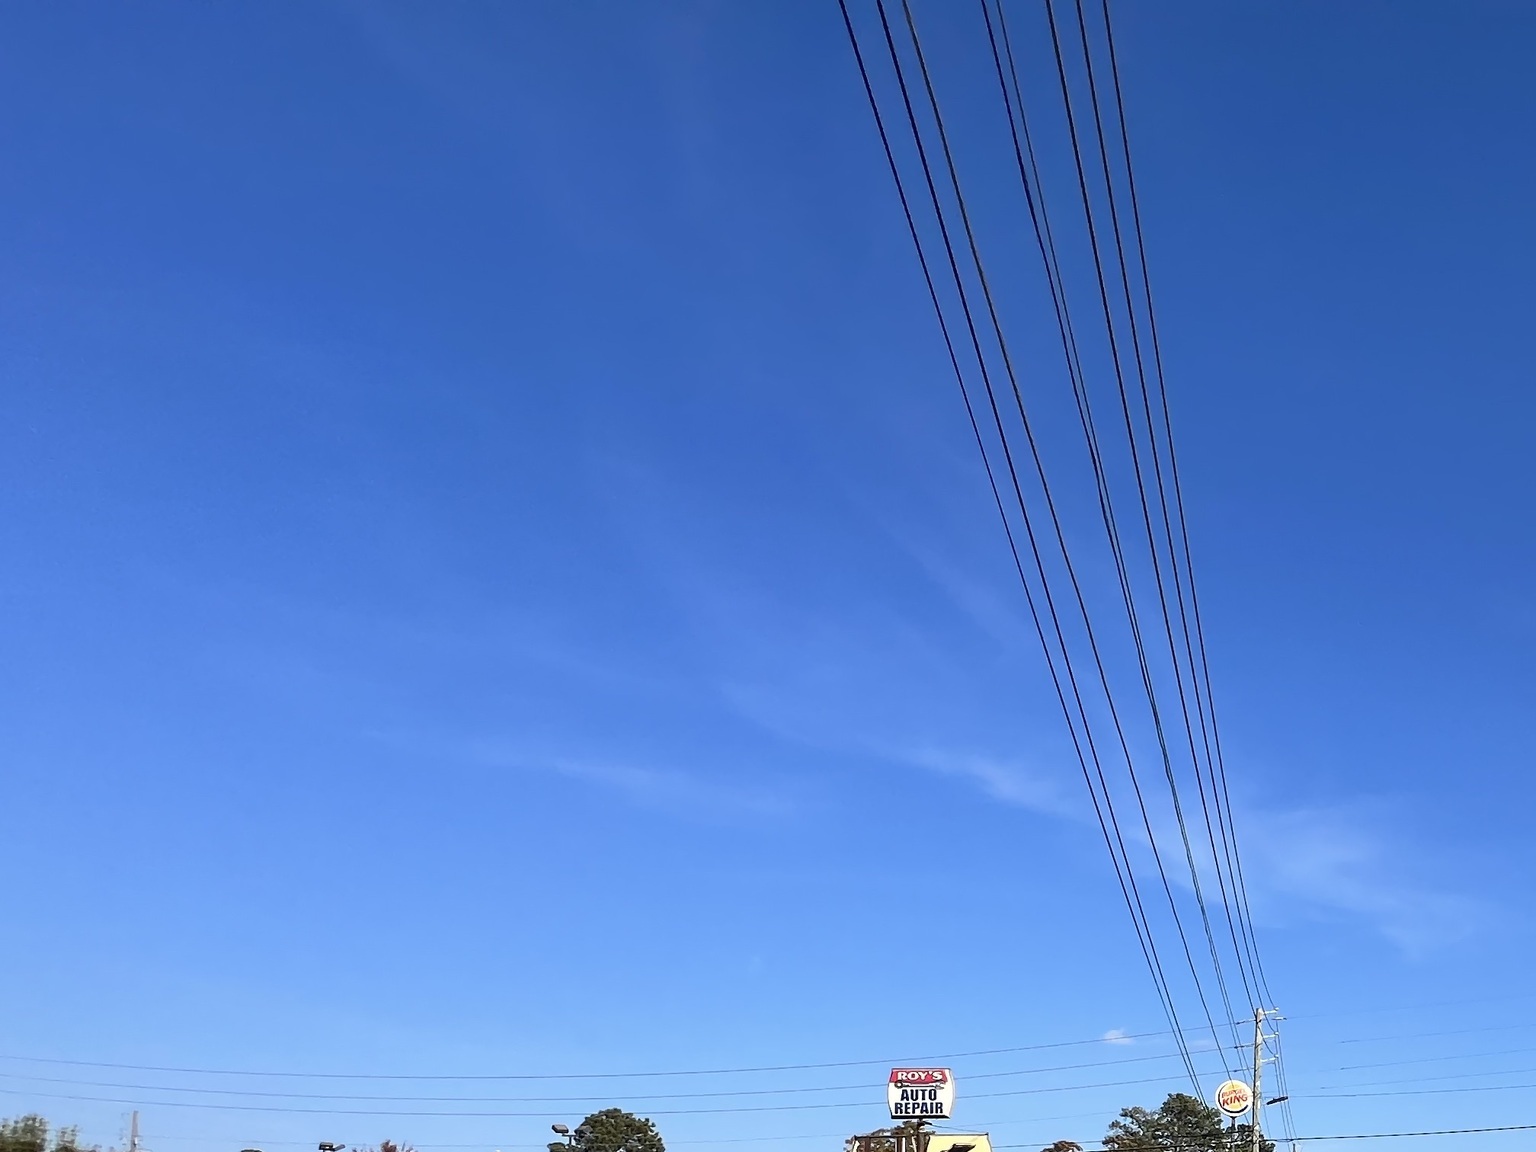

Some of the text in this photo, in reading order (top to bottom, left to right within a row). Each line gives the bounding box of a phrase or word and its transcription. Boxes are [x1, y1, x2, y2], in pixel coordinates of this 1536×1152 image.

[897, 1071, 943, 1080] ROY'S
[901, 1089, 937, 1101] AUTO
[1222, 1094, 1248, 1107] KING
[894, 1102, 944, 1115] REPAIR
